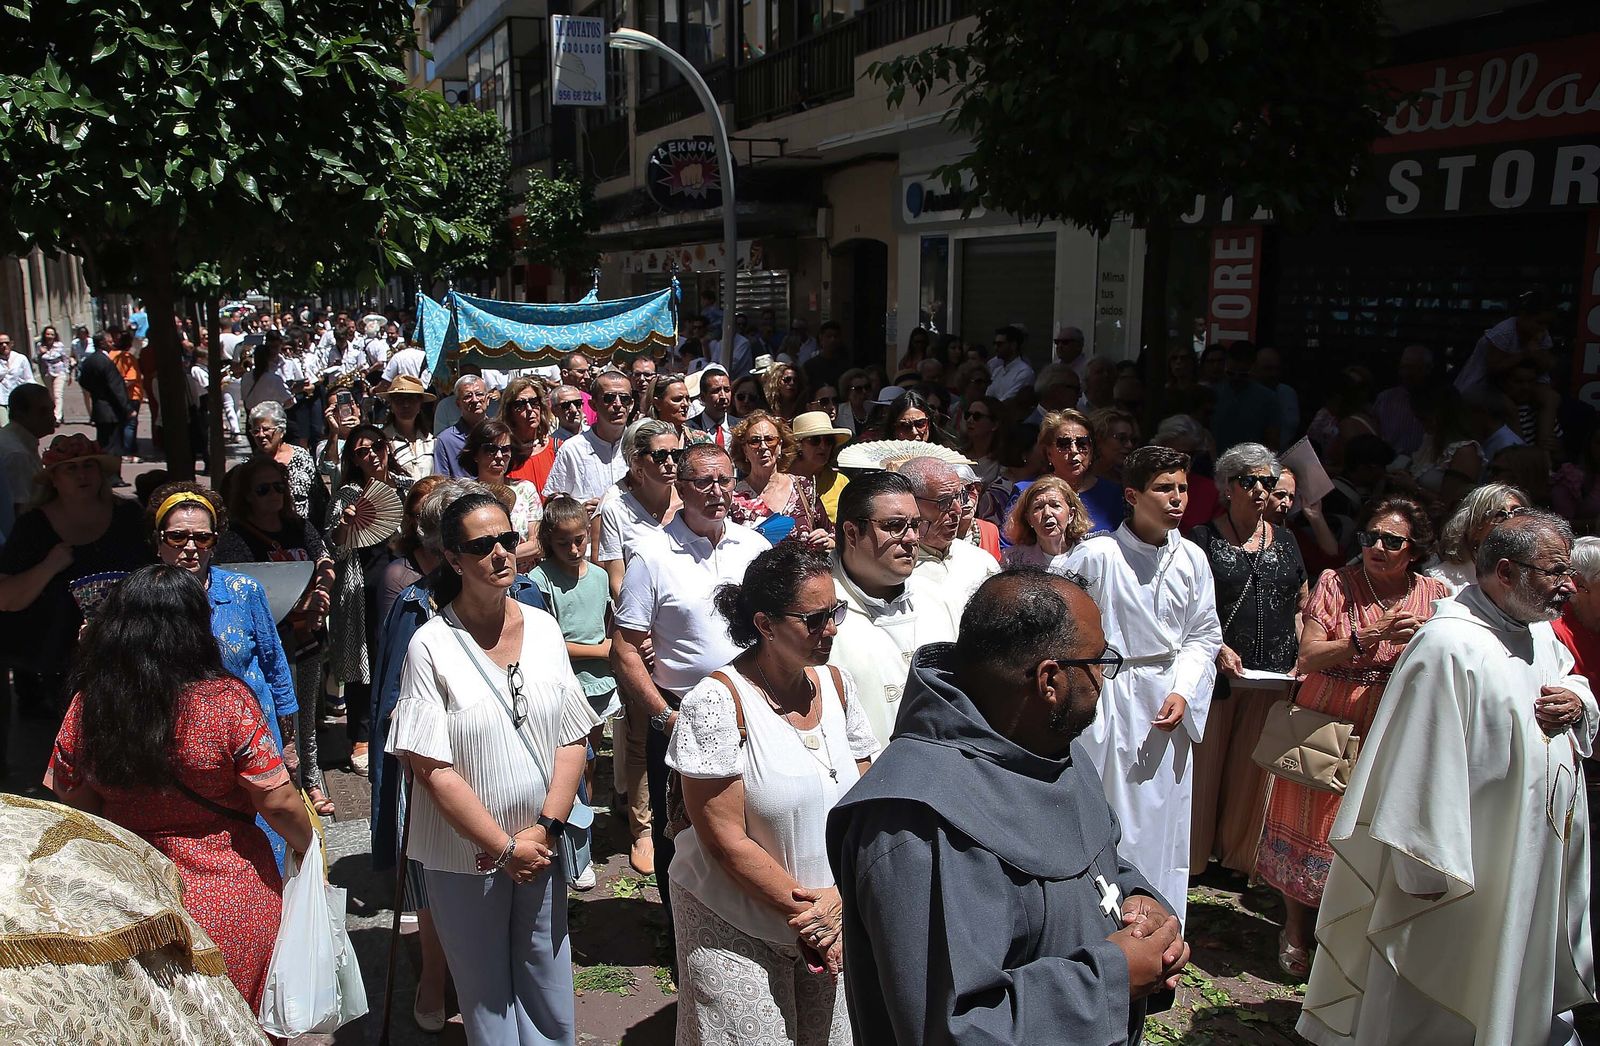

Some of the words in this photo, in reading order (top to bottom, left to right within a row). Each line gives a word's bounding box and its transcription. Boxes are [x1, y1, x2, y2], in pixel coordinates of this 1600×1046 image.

[566, 20, 602, 38] POYATOS
[649, 141, 717, 166] TAEKWON
[1102, 271, 1125, 282] Mima
[1101, 288, 1114, 298] tus
[1210, 236, 1255, 345] TORE
